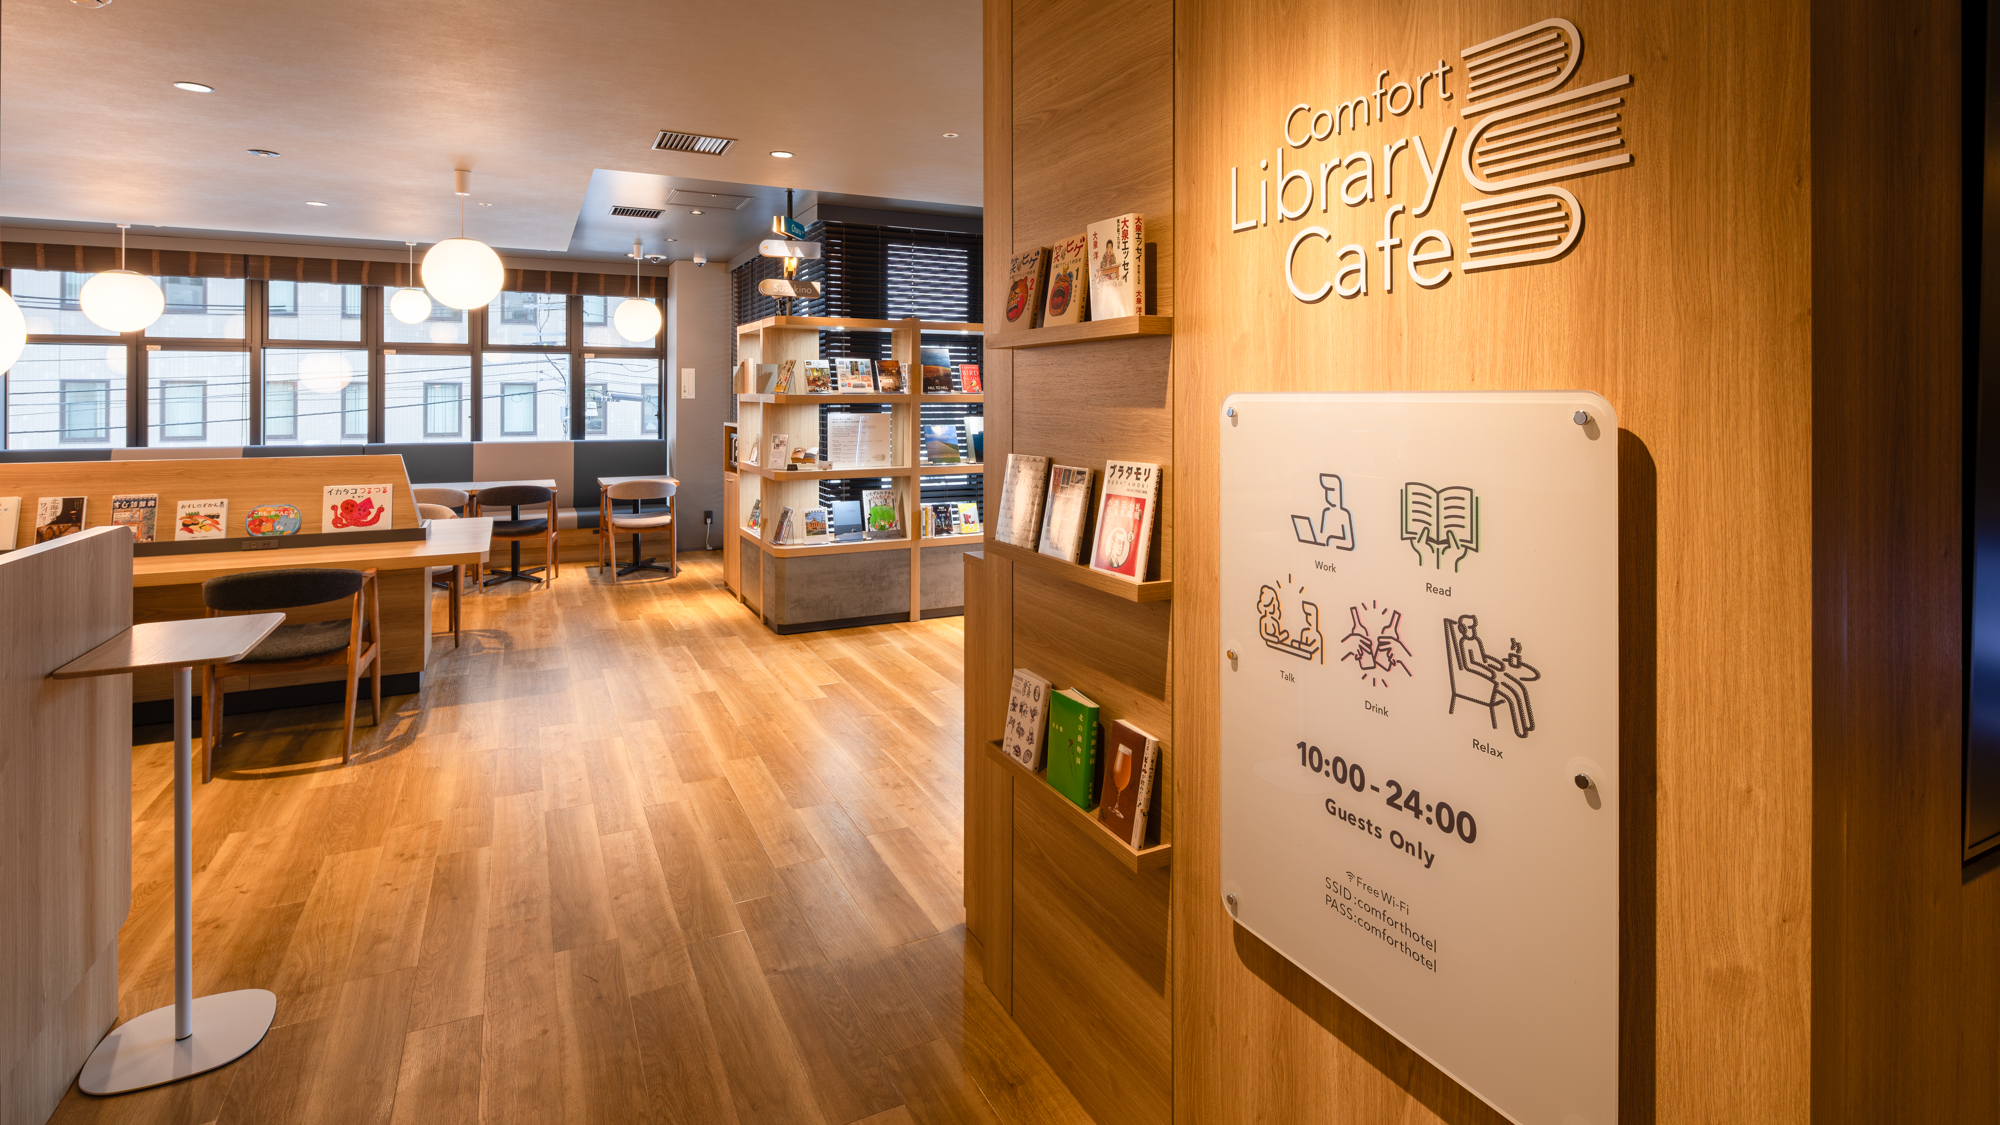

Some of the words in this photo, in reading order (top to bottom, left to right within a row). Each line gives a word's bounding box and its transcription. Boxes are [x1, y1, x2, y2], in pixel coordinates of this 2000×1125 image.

[1284, 59, 1452, 148] Comfort
[1231, 126, 1457, 231] Library
[1134, 216, 1142, 262] 大泉エッセイ
[1121, 217, 1130, 283] 大泉エッセイ
[1285, 204, 1453, 302] Cafe
[773, 283, 812, 294] Susukino
[1029, 278, 1035, 290] 2
[1109, 464, 1151, 482] ブラタモリ
[1314, 559, 1337, 574] Work
[1425, 582, 1452, 598] Read
[1279, 670, 1296, 684] Talk
[1364, 700, 1390, 718] Drink
[1472, 738, 1504, 760] Relax
[1324, 798, 1383, 839] Guests
[1389, 830, 1435, 869] Only
